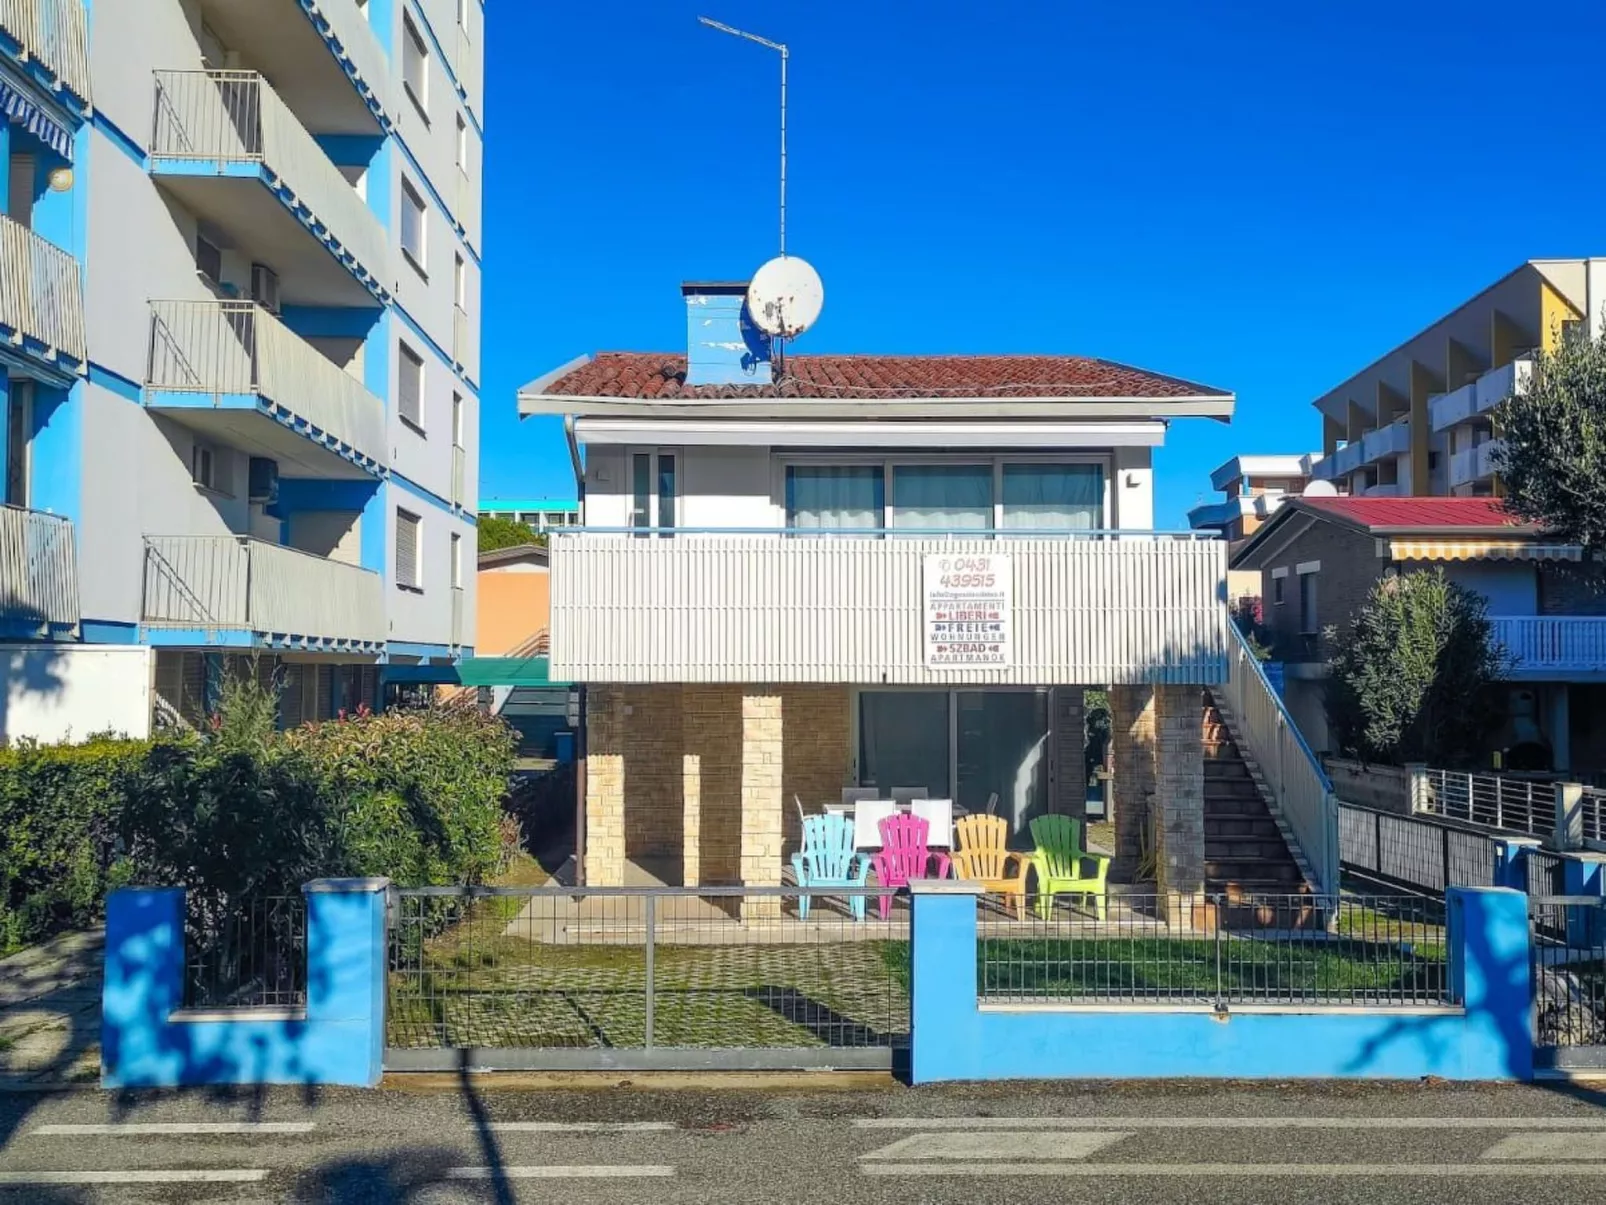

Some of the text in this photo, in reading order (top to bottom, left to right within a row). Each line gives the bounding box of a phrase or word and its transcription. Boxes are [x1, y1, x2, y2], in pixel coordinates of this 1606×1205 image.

[954, 558, 991, 572] 0431
[940, 573, 996, 588] 439515
[948, 611, 987, 621] LIBERI
[948, 623, 988, 632] FREIE
